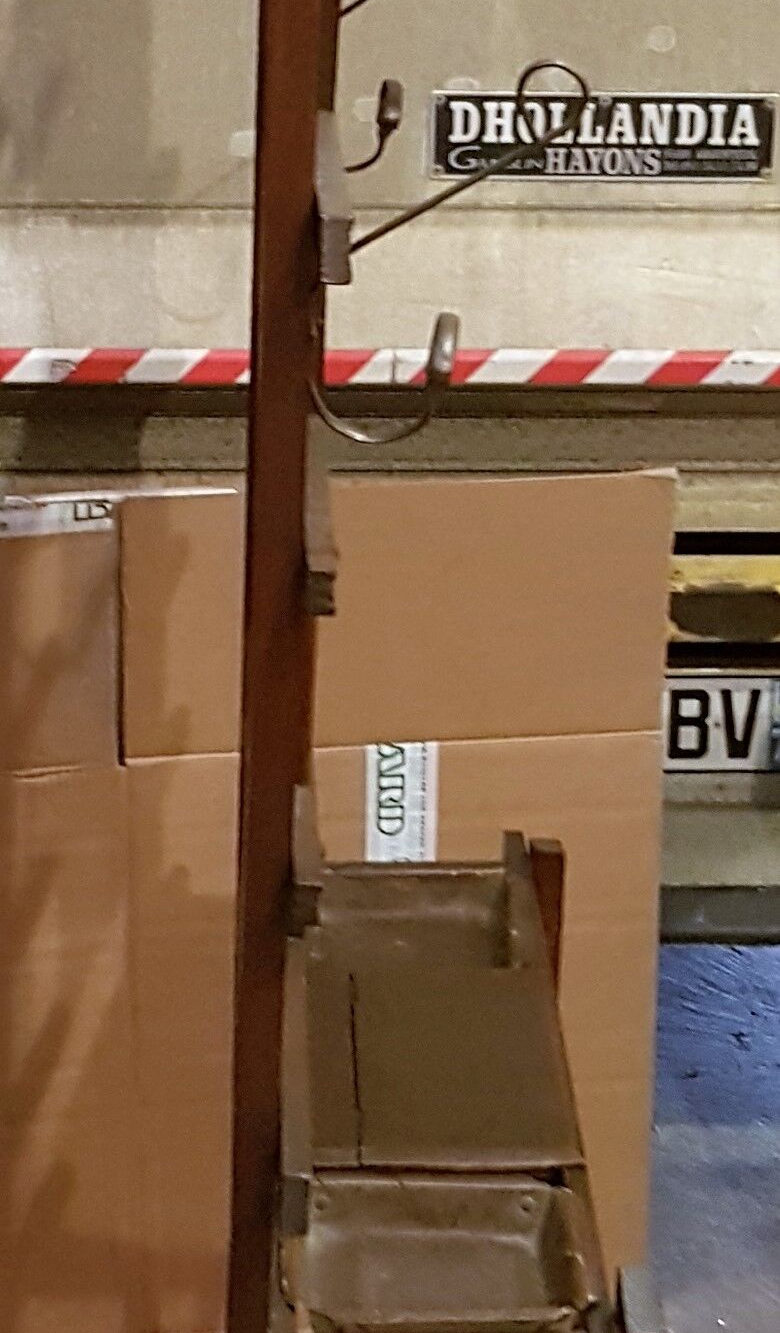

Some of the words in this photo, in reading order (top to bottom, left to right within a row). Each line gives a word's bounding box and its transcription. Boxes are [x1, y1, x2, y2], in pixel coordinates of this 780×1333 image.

[448, 101, 760, 146] DHOLLANDIA
[544, 148, 662, 175] HAYONS
[668, 689, 761, 759] BV
